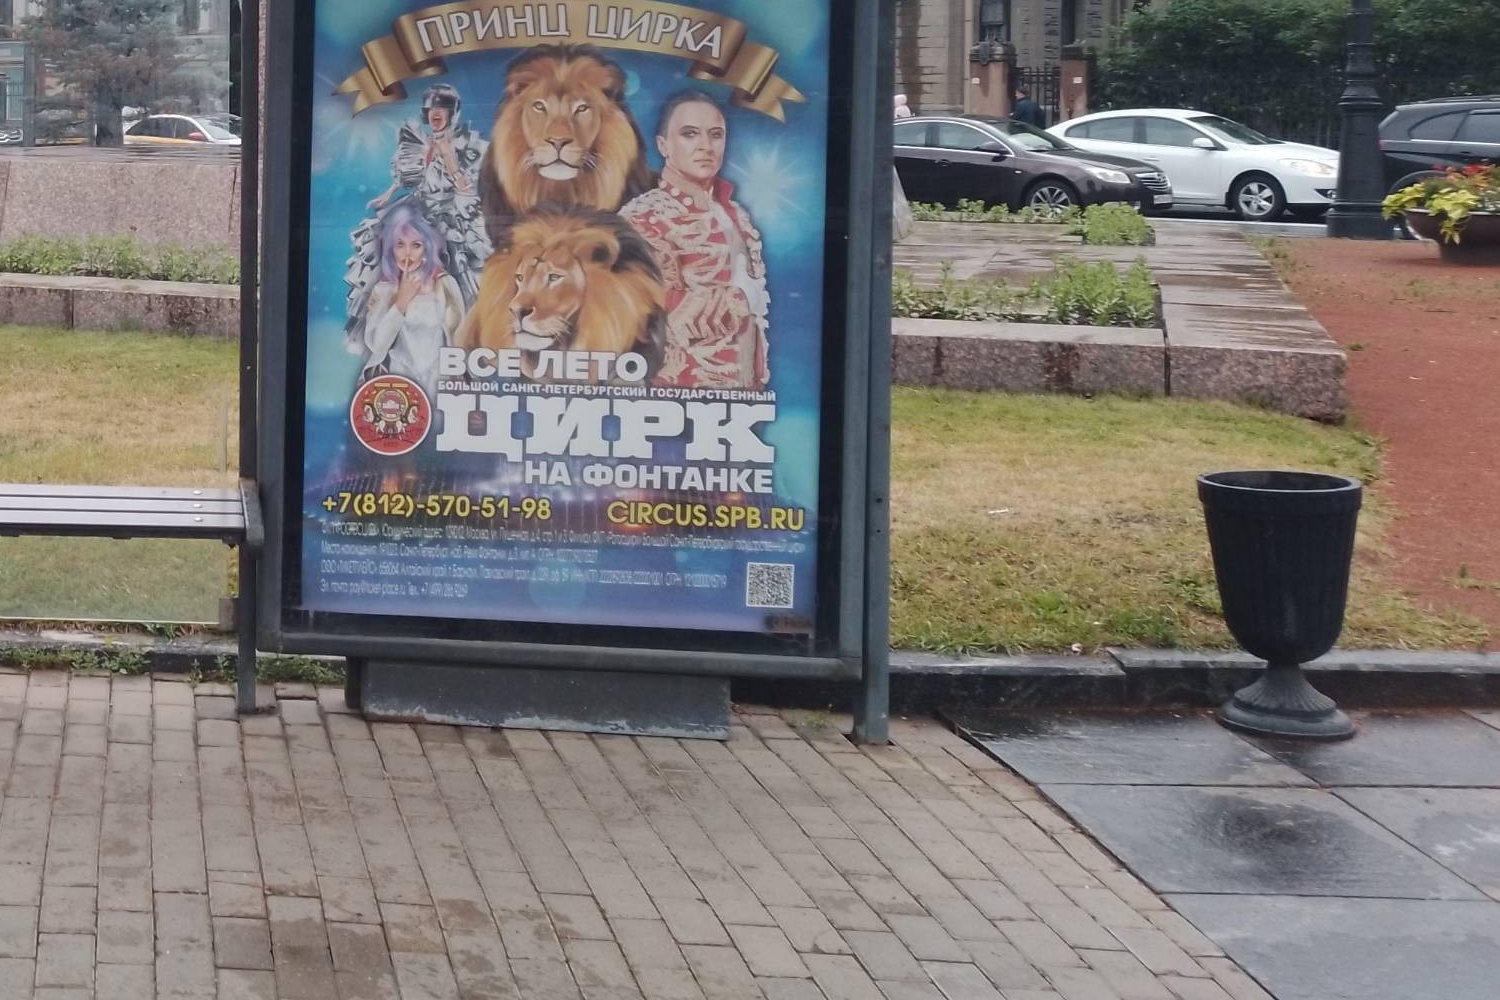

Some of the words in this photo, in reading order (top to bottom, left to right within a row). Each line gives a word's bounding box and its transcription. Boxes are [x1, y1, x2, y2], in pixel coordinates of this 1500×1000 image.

[415, 2, 571, 53] ПРИНЦ
[586, 4, 723, 59] ЦИРКА
[438, 347, 522, 378] ВСЕ
[533, 351, 649, 383] ЛЕТО
[437, 380, 500, 393] БОЛЬШОЙ
[501, 383, 648, 398] САНКТ-ПЕТЕРБУРГСКИЙ
[649, 387, 776, 403] ГОСУДАРСТВЕННЫЙ
[435, 393, 777, 464] ЦИРК
[523, 460, 573, 487] НА
[581, 462, 774, 494] ФОНТАНКЕ
[322, 491, 553, 521] +7(812)-570-51-98
[605, 500, 805, 532] CIRCUS.SPB.RU
